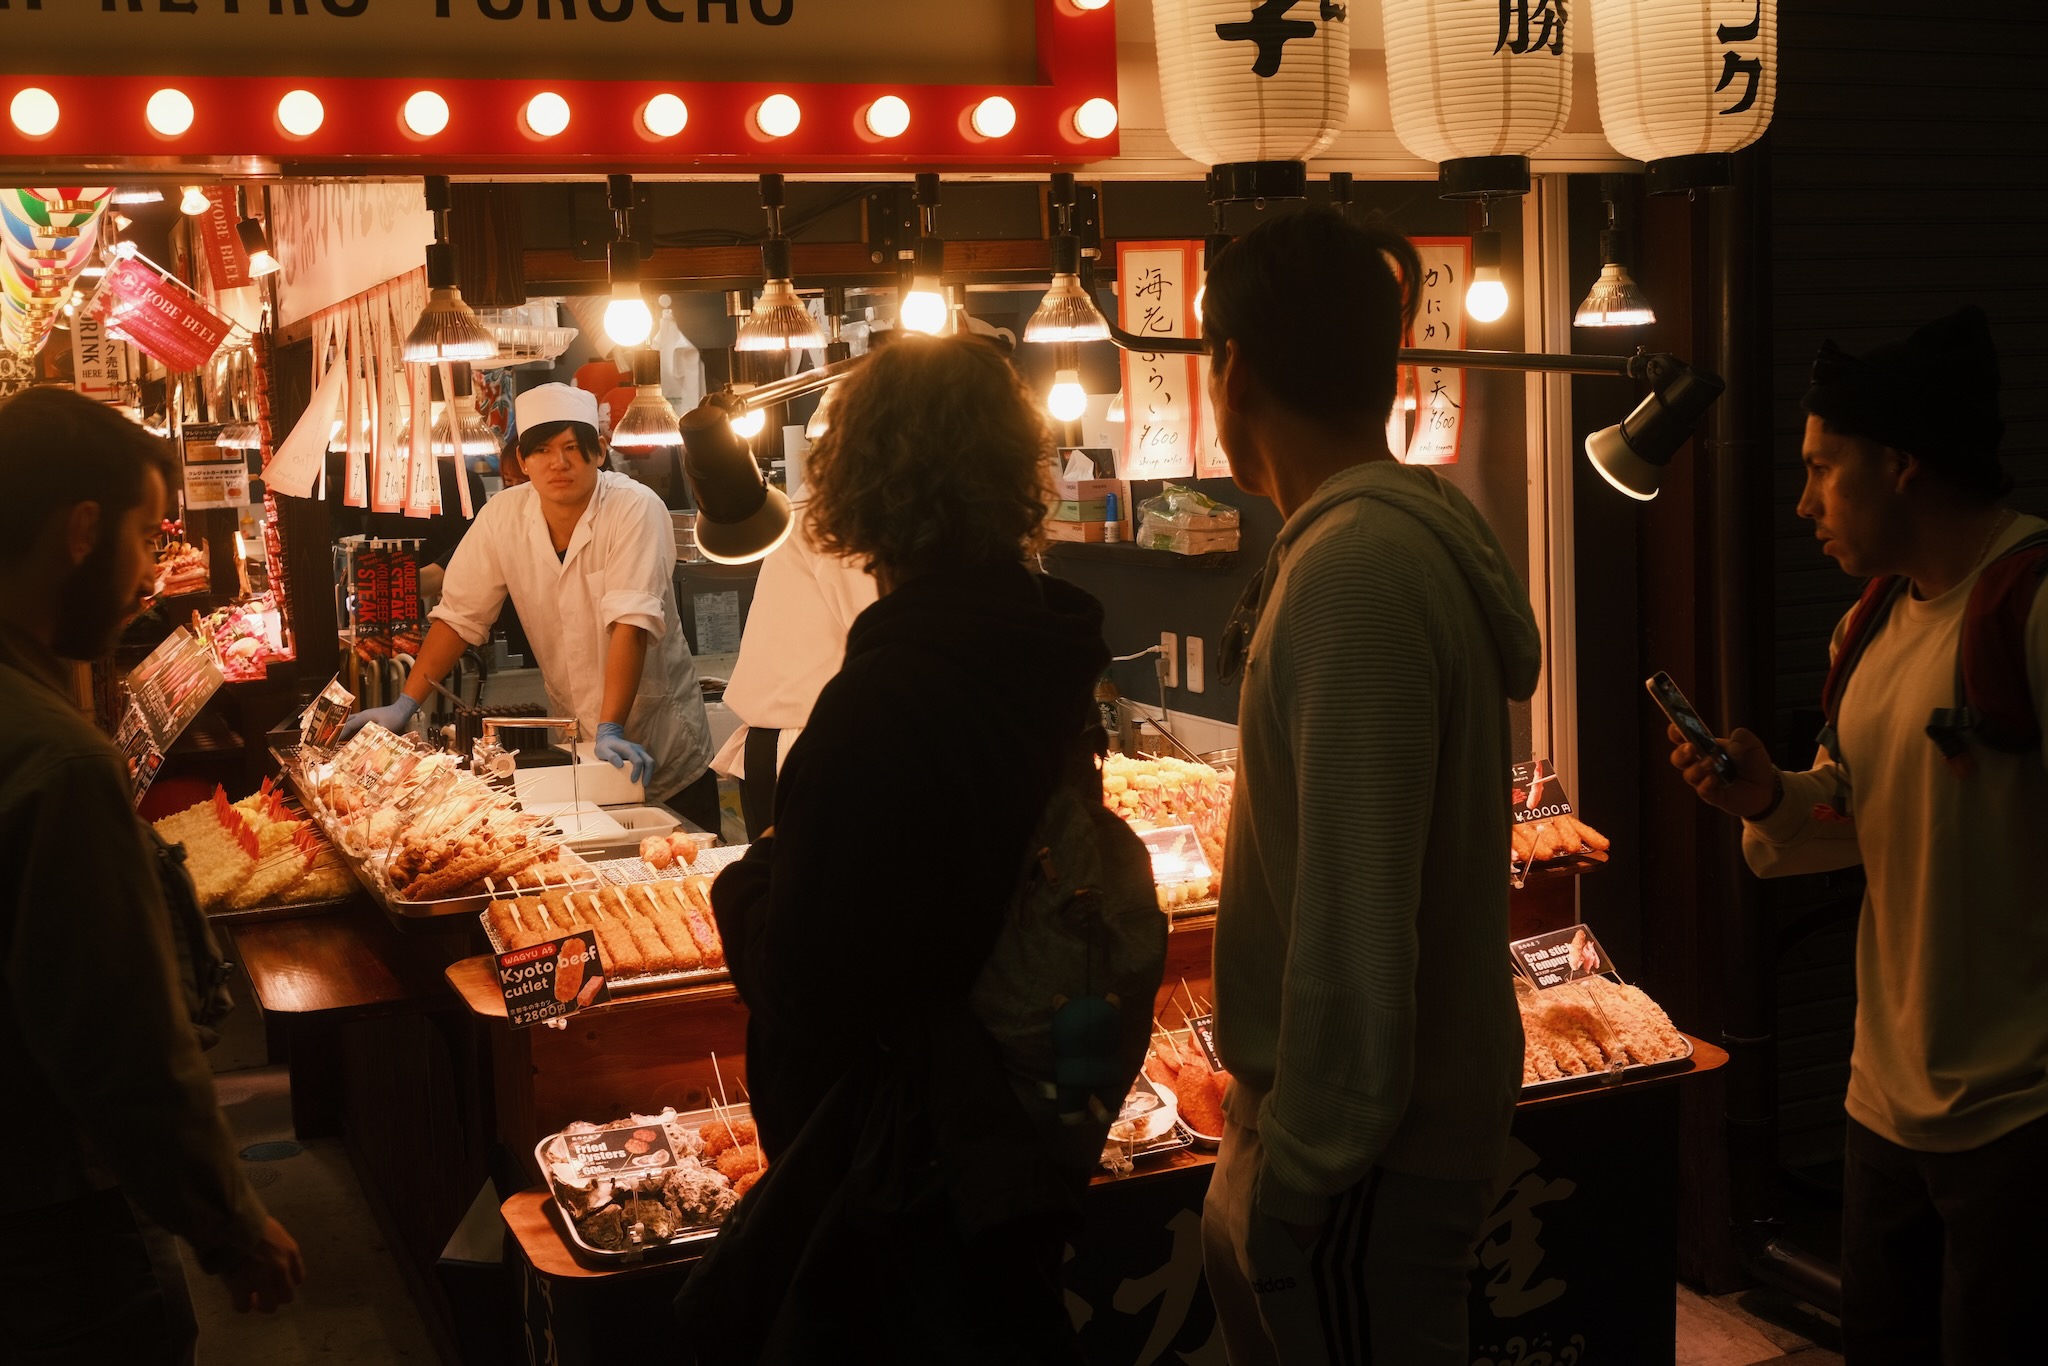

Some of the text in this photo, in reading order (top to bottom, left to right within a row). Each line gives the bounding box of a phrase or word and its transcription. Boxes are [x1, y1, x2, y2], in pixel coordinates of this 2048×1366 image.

[211, 198, 230, 240] KOBE
[141, 287, 182, 320] KOBE
[82, 371, 103, 379] HERE
[1429, 409, 1455, 432] ¥600
[1139, 424, 1179, 450] ¥600
[358, 568, 376, 622] STEAK
[392, 567, 405, 620] STEAK
[500, 945, 597, 985] Kyoto beef
[504, 946, 554, 965] WAGYU A5
[1523, 949, 1549, 963] Crab
[504, 977, 549, 999] cutlet
[574, 1141, 607, 1154] Fried
[577, 1150, 626, 1163] Oysters
